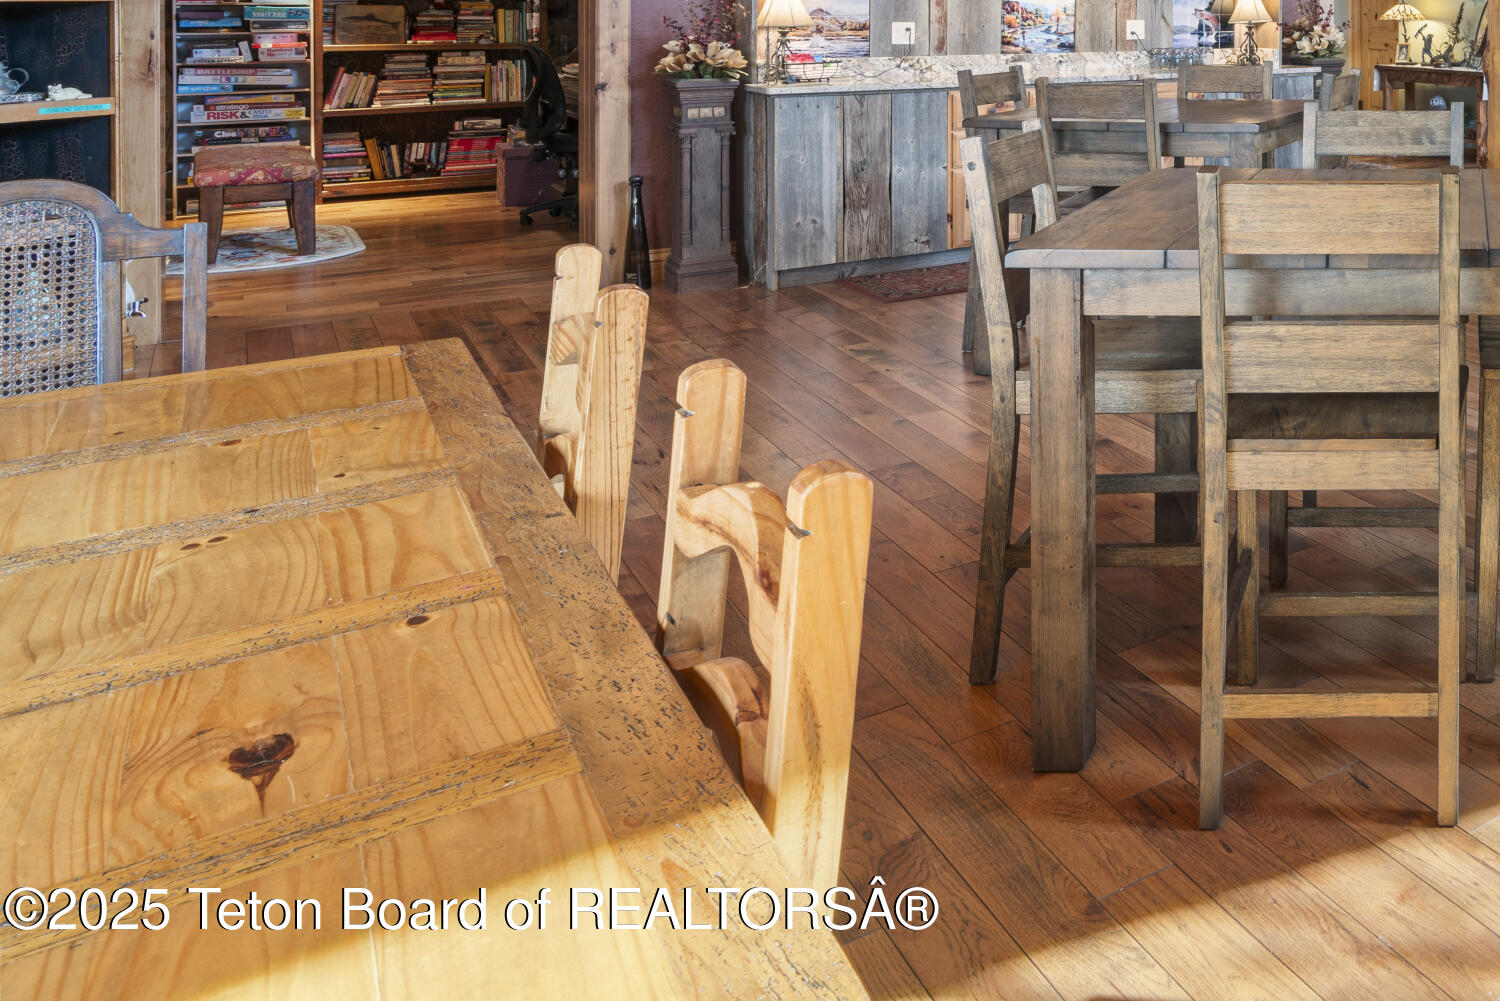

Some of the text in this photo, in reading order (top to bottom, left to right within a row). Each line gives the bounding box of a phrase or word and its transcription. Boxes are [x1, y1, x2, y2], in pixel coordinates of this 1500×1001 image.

[206, 110, 250, 120] RISK &
[213, 130, 237, 138] Clue
